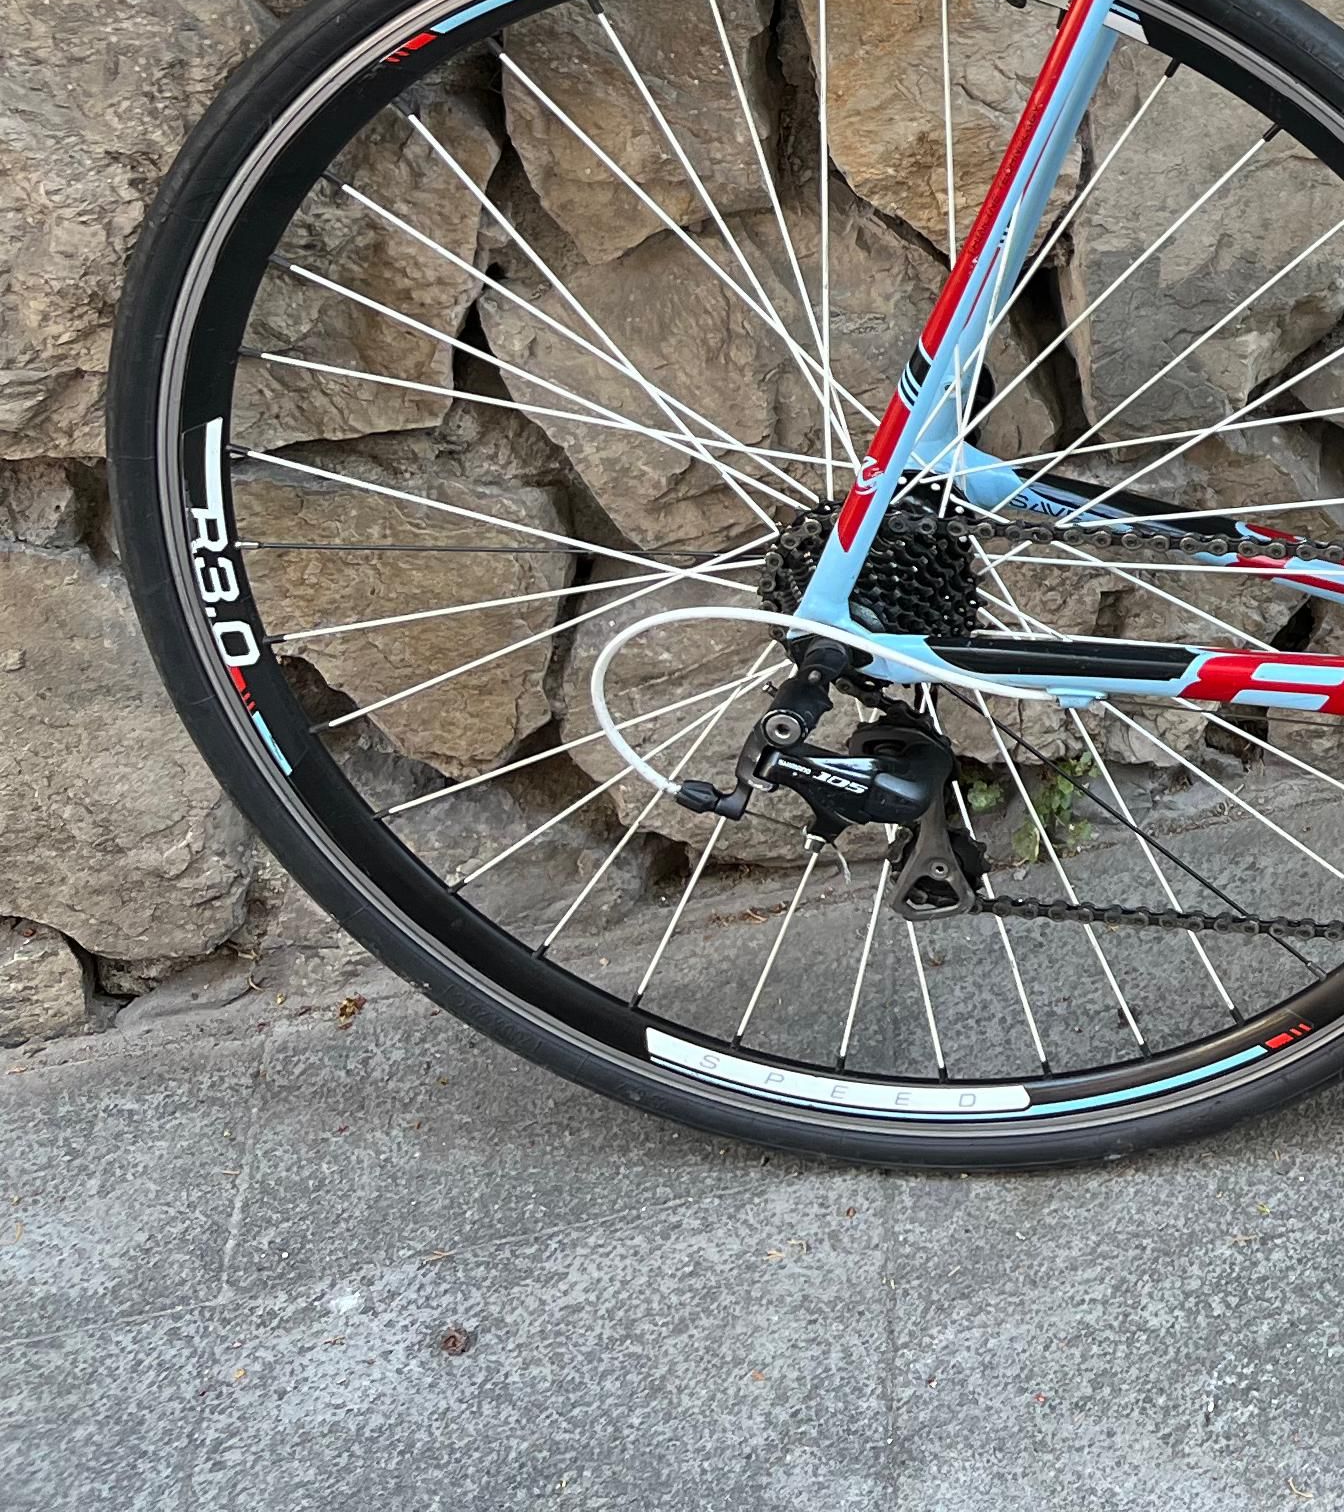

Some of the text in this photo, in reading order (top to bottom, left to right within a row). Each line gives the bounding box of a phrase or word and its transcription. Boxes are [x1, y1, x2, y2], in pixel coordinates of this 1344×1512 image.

[187, 507, 261, 667] R3.0
[812, 771, 869, 794] 105
[698, 1053, 978, 1109] SPEED
